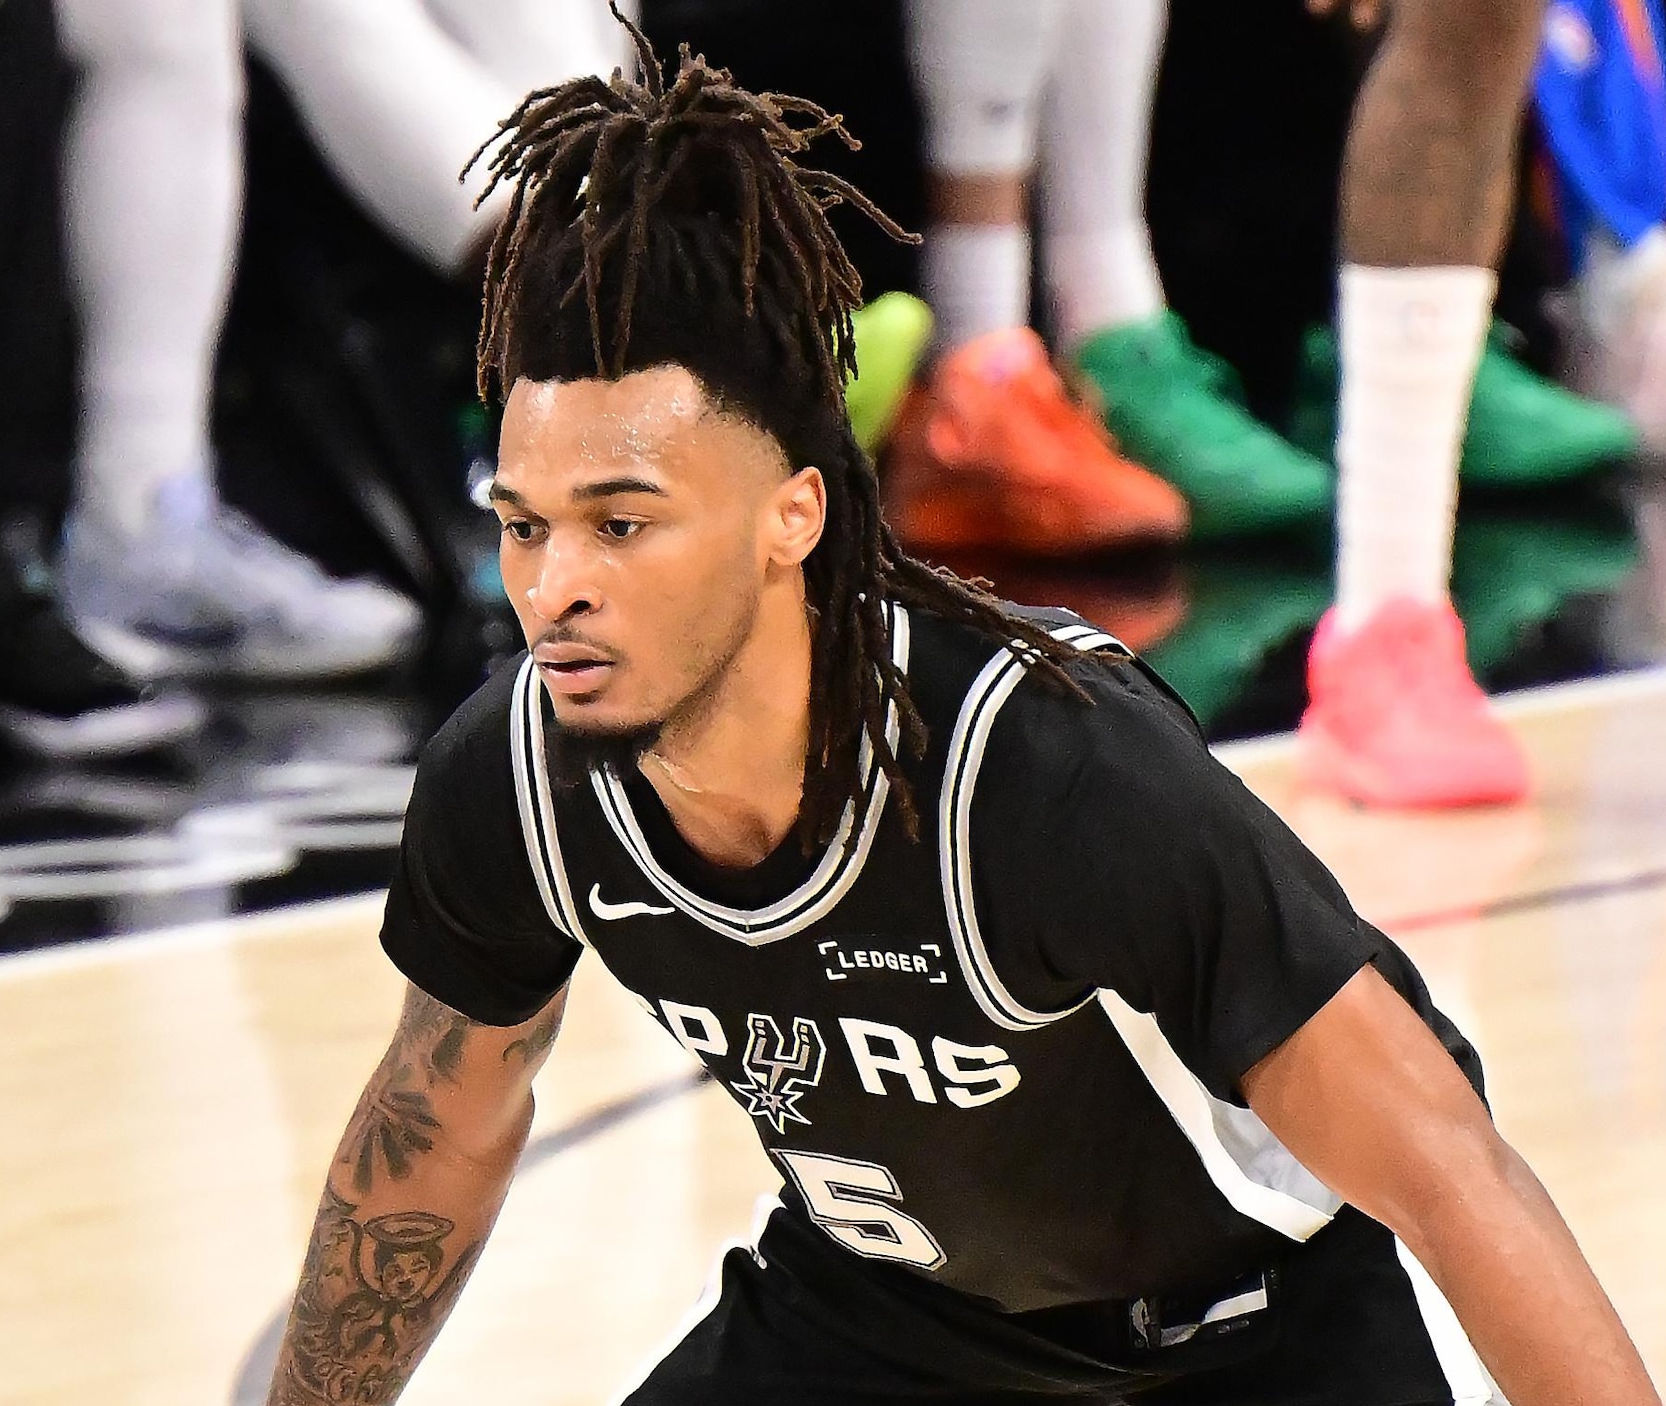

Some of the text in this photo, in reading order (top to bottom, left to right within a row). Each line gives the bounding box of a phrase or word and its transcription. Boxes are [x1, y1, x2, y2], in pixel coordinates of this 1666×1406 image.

[837, 950, 929, 974] LEDGER
[657, 998, 1023, 1135] PURS
[769, 1147, 948, 1272] 5
